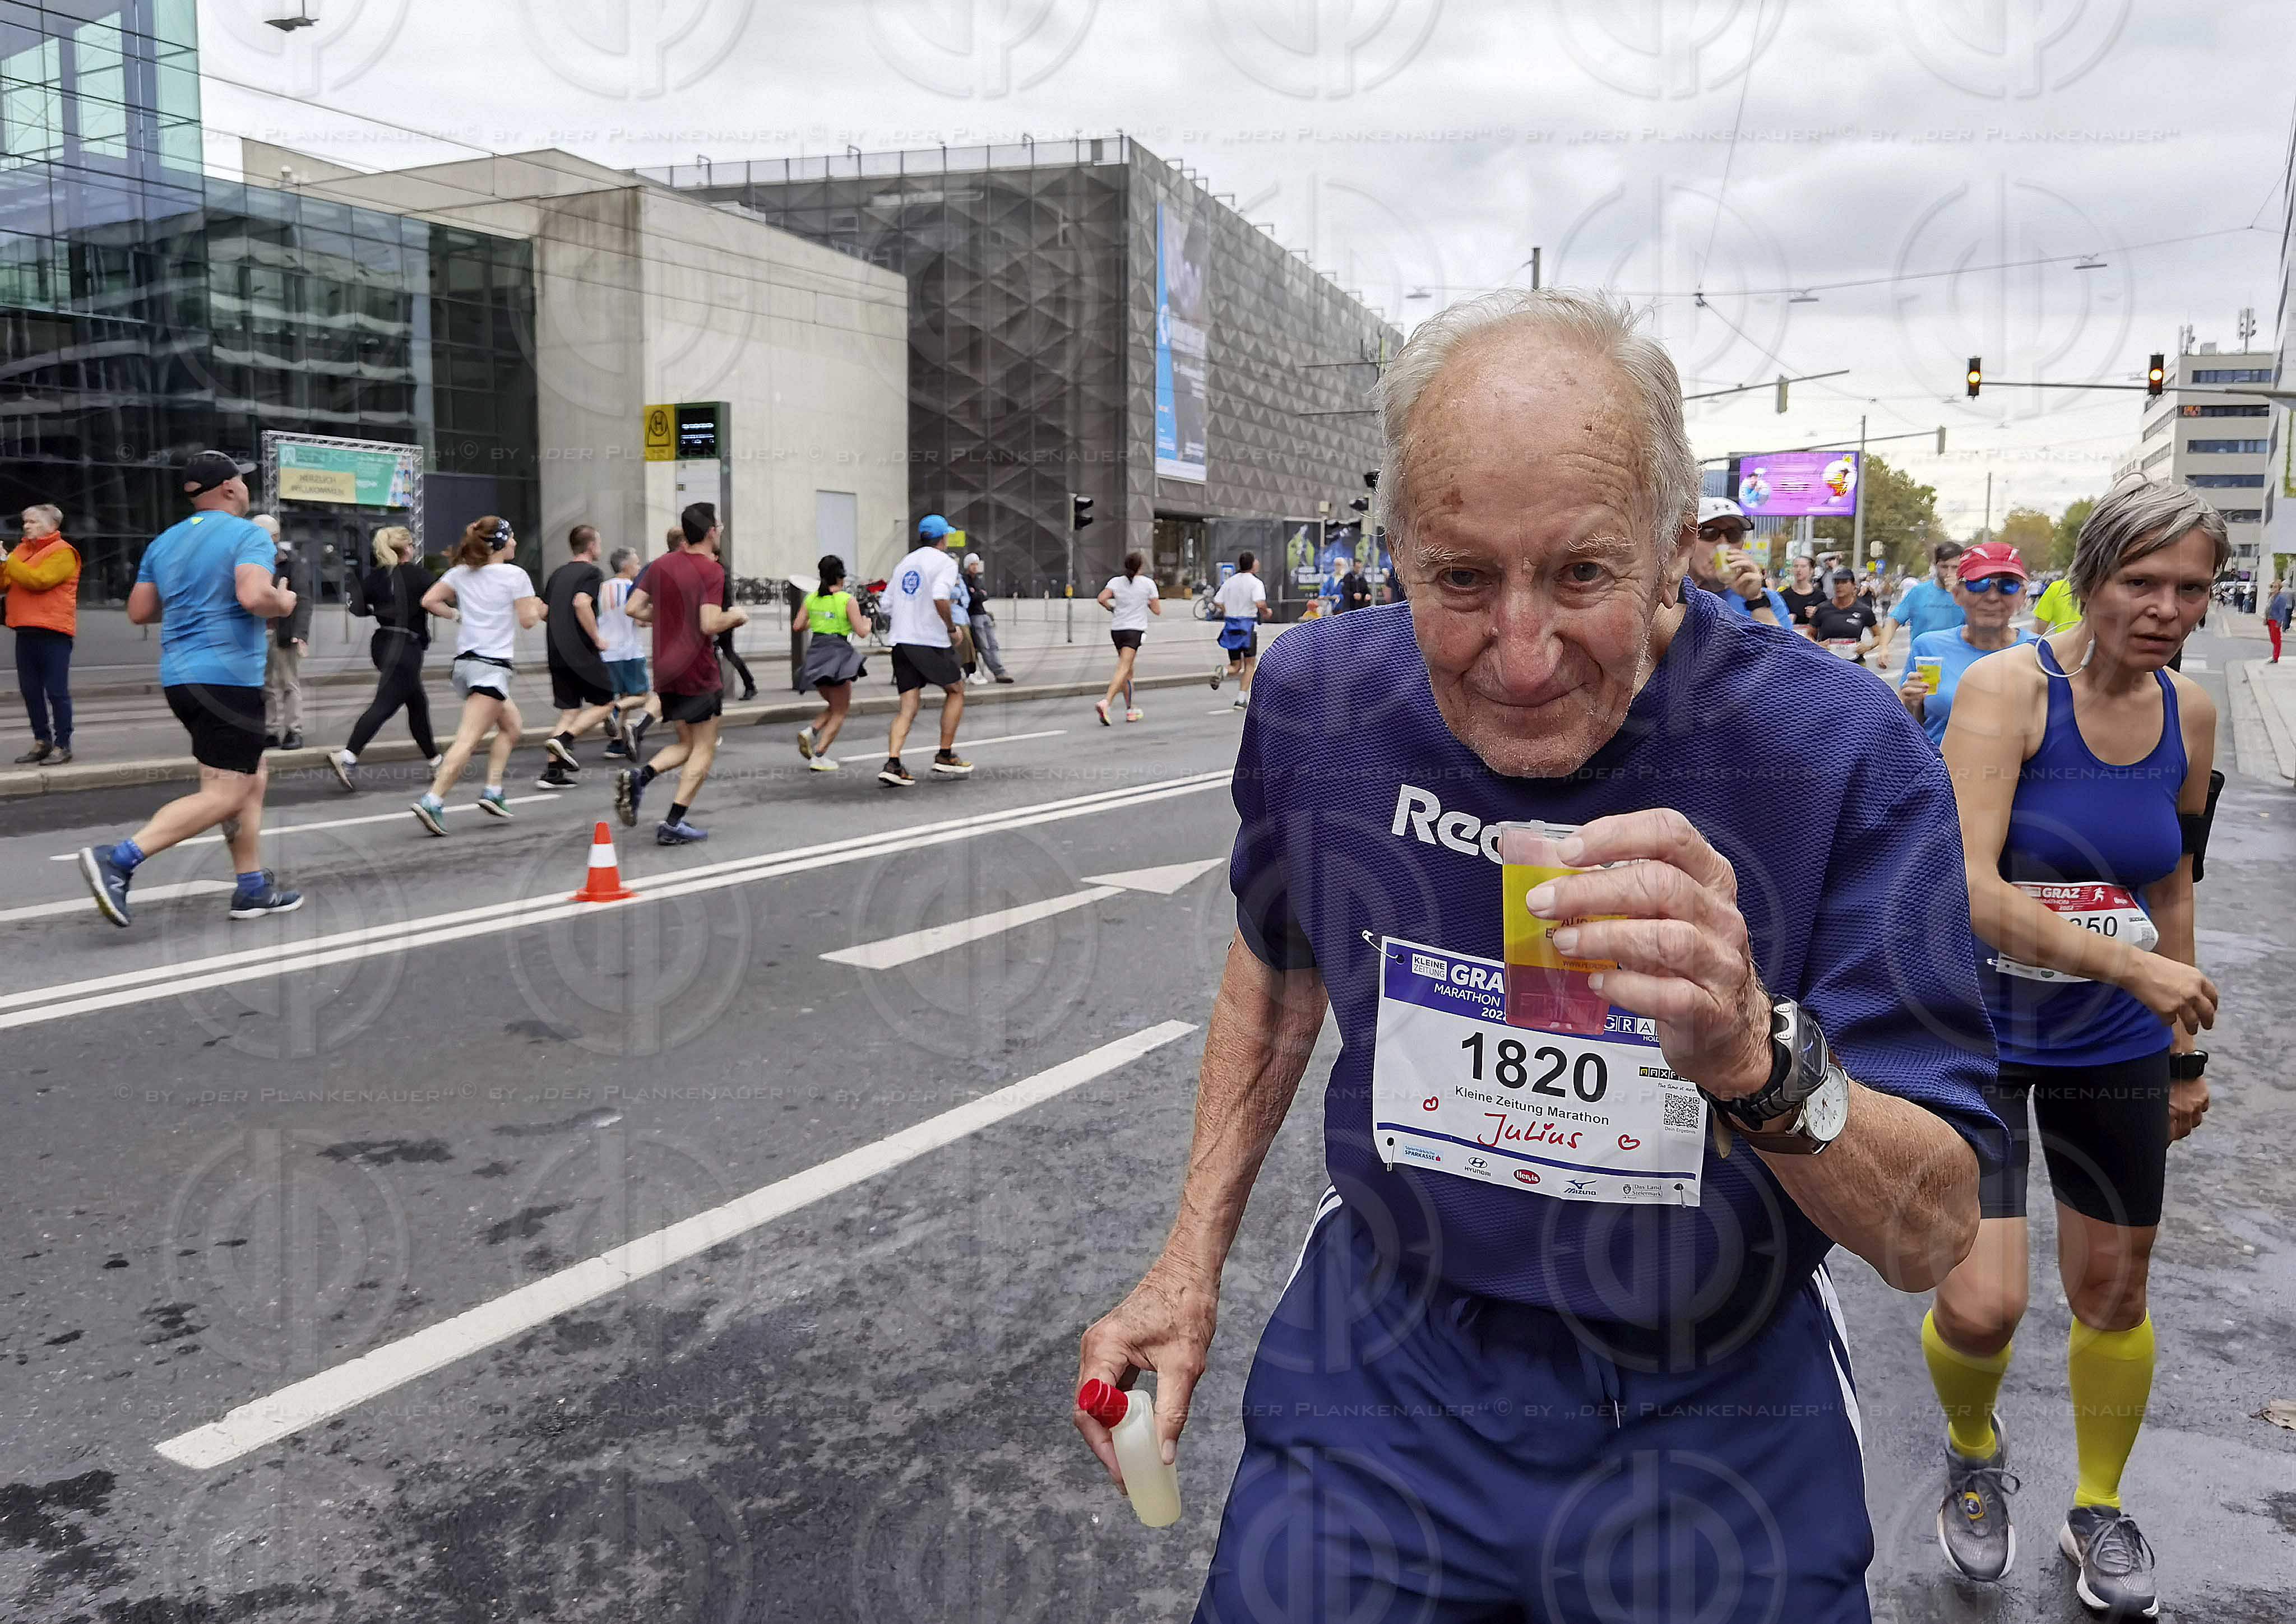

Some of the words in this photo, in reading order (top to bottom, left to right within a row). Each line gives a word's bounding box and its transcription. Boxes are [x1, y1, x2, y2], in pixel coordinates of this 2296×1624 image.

[2042, 887, 2081, 899] GRAZ
[1414, 956, 1445, 970] KLEINE
[1413, 965, 1445, 978] ZEITUNG
[1450, 964, 1505, 994] GRA
[1434, 982, 1501, 1007] MARATHON
[1604, 1015, 1654, 1034] GRA
[1461, 1031, 1608, 1103] 1820
[1455, 1085, 1493, 1103] Kleine
[1496, 1094, 1543, 1116] Zeitung
[1547, 1106, 1609, 1126] Marathon
[1404, 1150, 1436, 1161] SPARKASSE
[1464, 1166, 1492, 1177] HYUNDAI
[1516, 1170, 1539, 1182] Hervis
